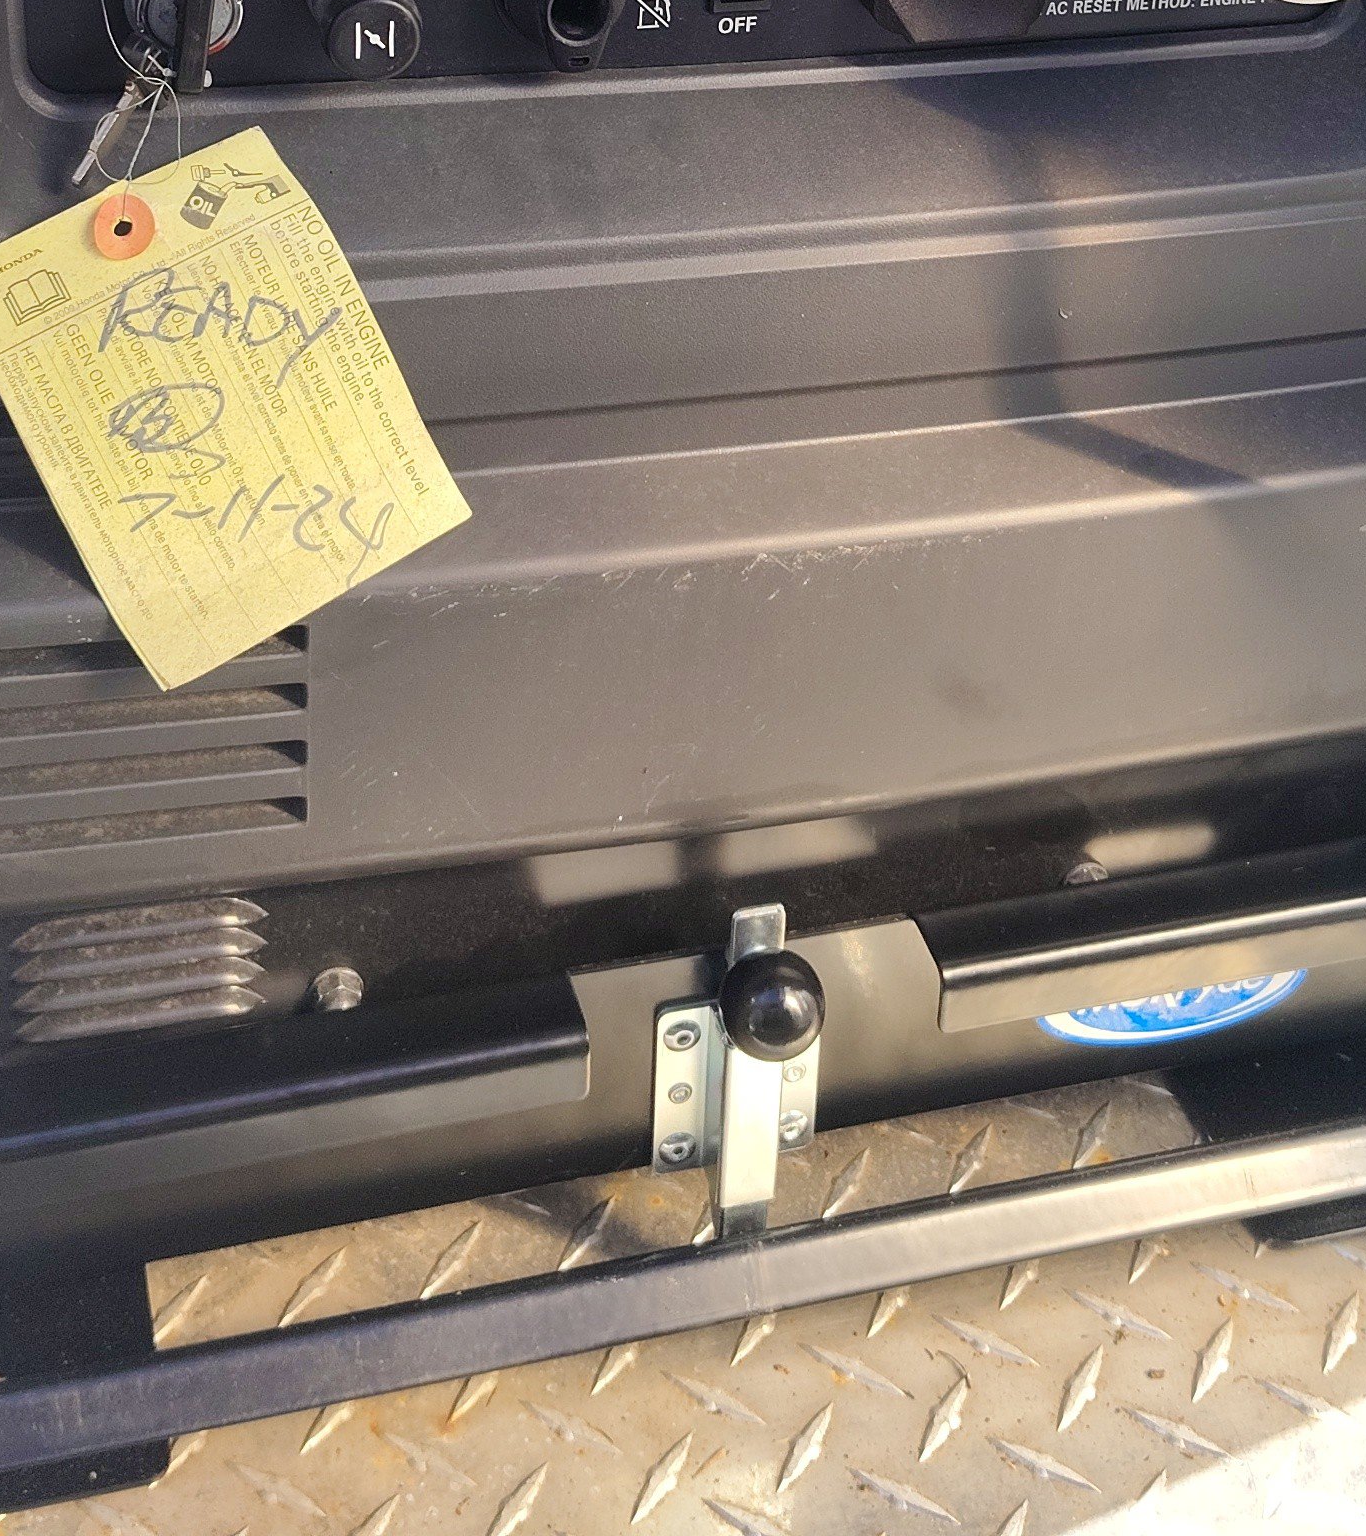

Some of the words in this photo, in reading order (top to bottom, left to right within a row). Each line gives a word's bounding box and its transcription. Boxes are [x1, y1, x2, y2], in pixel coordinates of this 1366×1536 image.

[718, 16, 758, 35] OFF
[1046, 2, 1068, 15] AC
[188, 193, 217, 220] OIL
[282, 212, 302, 237] Fill
[298, 204, 324, 237] NO
[75, 287, 105, 308] Honda
[174, 247, 187, 259] All
[186, 232, 216, 253] Rights
[214, 212, 256, 238] Reserved
[296, 237, 316, 264] the
[315, 237, 343, 273] OIL
[308, 263, 343, 317] engine
[332, 272, 355, 298] IN
[97, 266, 341, 389] READY
[241, 233, 280, 295] MOTEUR
[272, 294, 299, 334] LIVRE
[291, 333, 319, 373] SANS
[309, 371, 339, 412] HUILE
[269, 219, 301, 269] before
[292, 269, 330, 328] starting
[323, 327, 344, 353] the
[334, 352, 369, 406] engine.
[334, 316, 358, 350] with
[343, 297, 391, 370] ENGINE
[153, 278, 178, 312] KEIN
[180, 331, 198, 350] IM
[190, 349, 222, 398] MOTOR
[198, 254, 217, 276] NO
[209, 275, 230, 303] HAY
[222, 300, 251, 343] ACEITE
[241, 341, 258, 360] EN
[250, 358, 266, 375] EL
[258, 373, 288, 418] MOTOR
[19, 344, 43, 374] НЕТ
[350, 349, 369, 370] oil
[359, 370, 376, 388] to
[33, 372, 68, 424] МАСЛА
[64, 321, 97, 368] GEEN
[87, 367, 116, 405] OLIE
[106, 404, 124, 423] IN
[116, 423, 154, 481] MOTOR
[115, 312, 152, 368] MOTORE
[143, 366, 168, 399] NON
[158, 397, 198, 459] CONTIENE
[188, 456, 212, 487] OLIO
[367, 386, 387, 410] the
[60, 422, 74, 435] В
[377, 409, 410, 460] correct
[4, 351, 31, 387] Перед
[22, 386, 54, 434] запуском
[71, 479, 103, 530] двигатель
[96, 529, 128, 577] моторное
[33, 430, 61, 472] уровня.
[50, 329, 67, 349] Vul
[84, 396, 99, 414] tot
[92, 412, 109, 431] het
[114, 457, 133, 479] peil
[124, 476, 140, 493] bij
[153, 528, 168, 544] de
[161, 542, 183, 574] motor
[178, 573, 190, 585] te
[65, 433, 113, 510] ДВИГАТЕЛЕ
[402, 458, 429, 496] level
